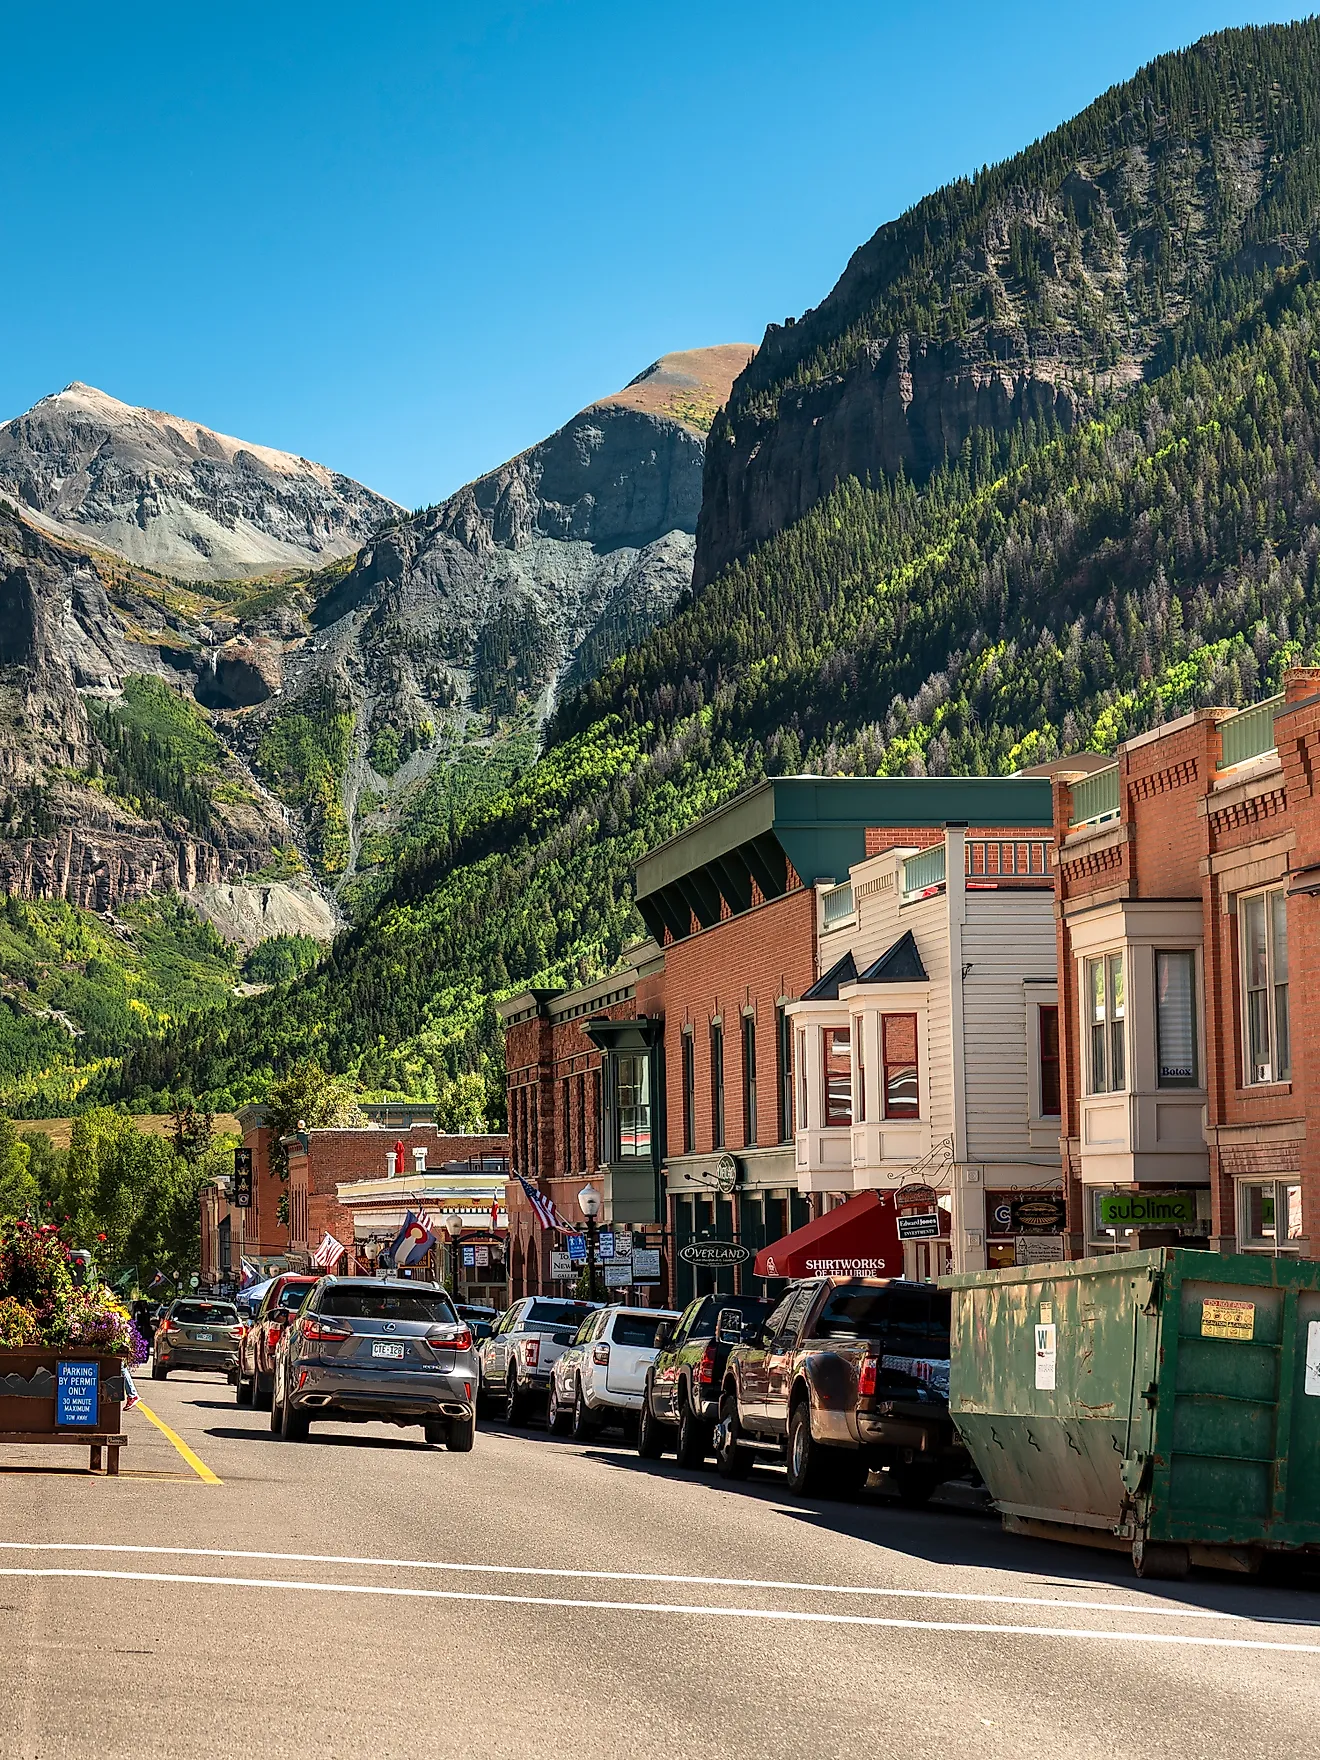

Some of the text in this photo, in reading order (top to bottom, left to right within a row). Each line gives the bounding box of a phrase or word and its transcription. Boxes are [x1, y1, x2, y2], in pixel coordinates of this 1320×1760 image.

[1162, 1066, 1191, 1076] Botox
[1108, 1198, 1187, 1220] sublime
[899, 1217, 937, 1227] Edward Jones
[903, 1228, 935, 1237] INVESTMENTS
[684, 1247, 746, 1259] OVERLAND
[553, 1262, 572, 1270] NEW
[805, 1258, 886, 1270] SHIRTWORKS
[62, 1367, 93, 1376] PARKING
[58, 1377, 97, 1386] BY PERMIT
[68, 1387, 86, 1396] ONLY
[71, 1398, 92, 1406] MINUTE
[64, 1405, 90, 1413] MAXIMUM
